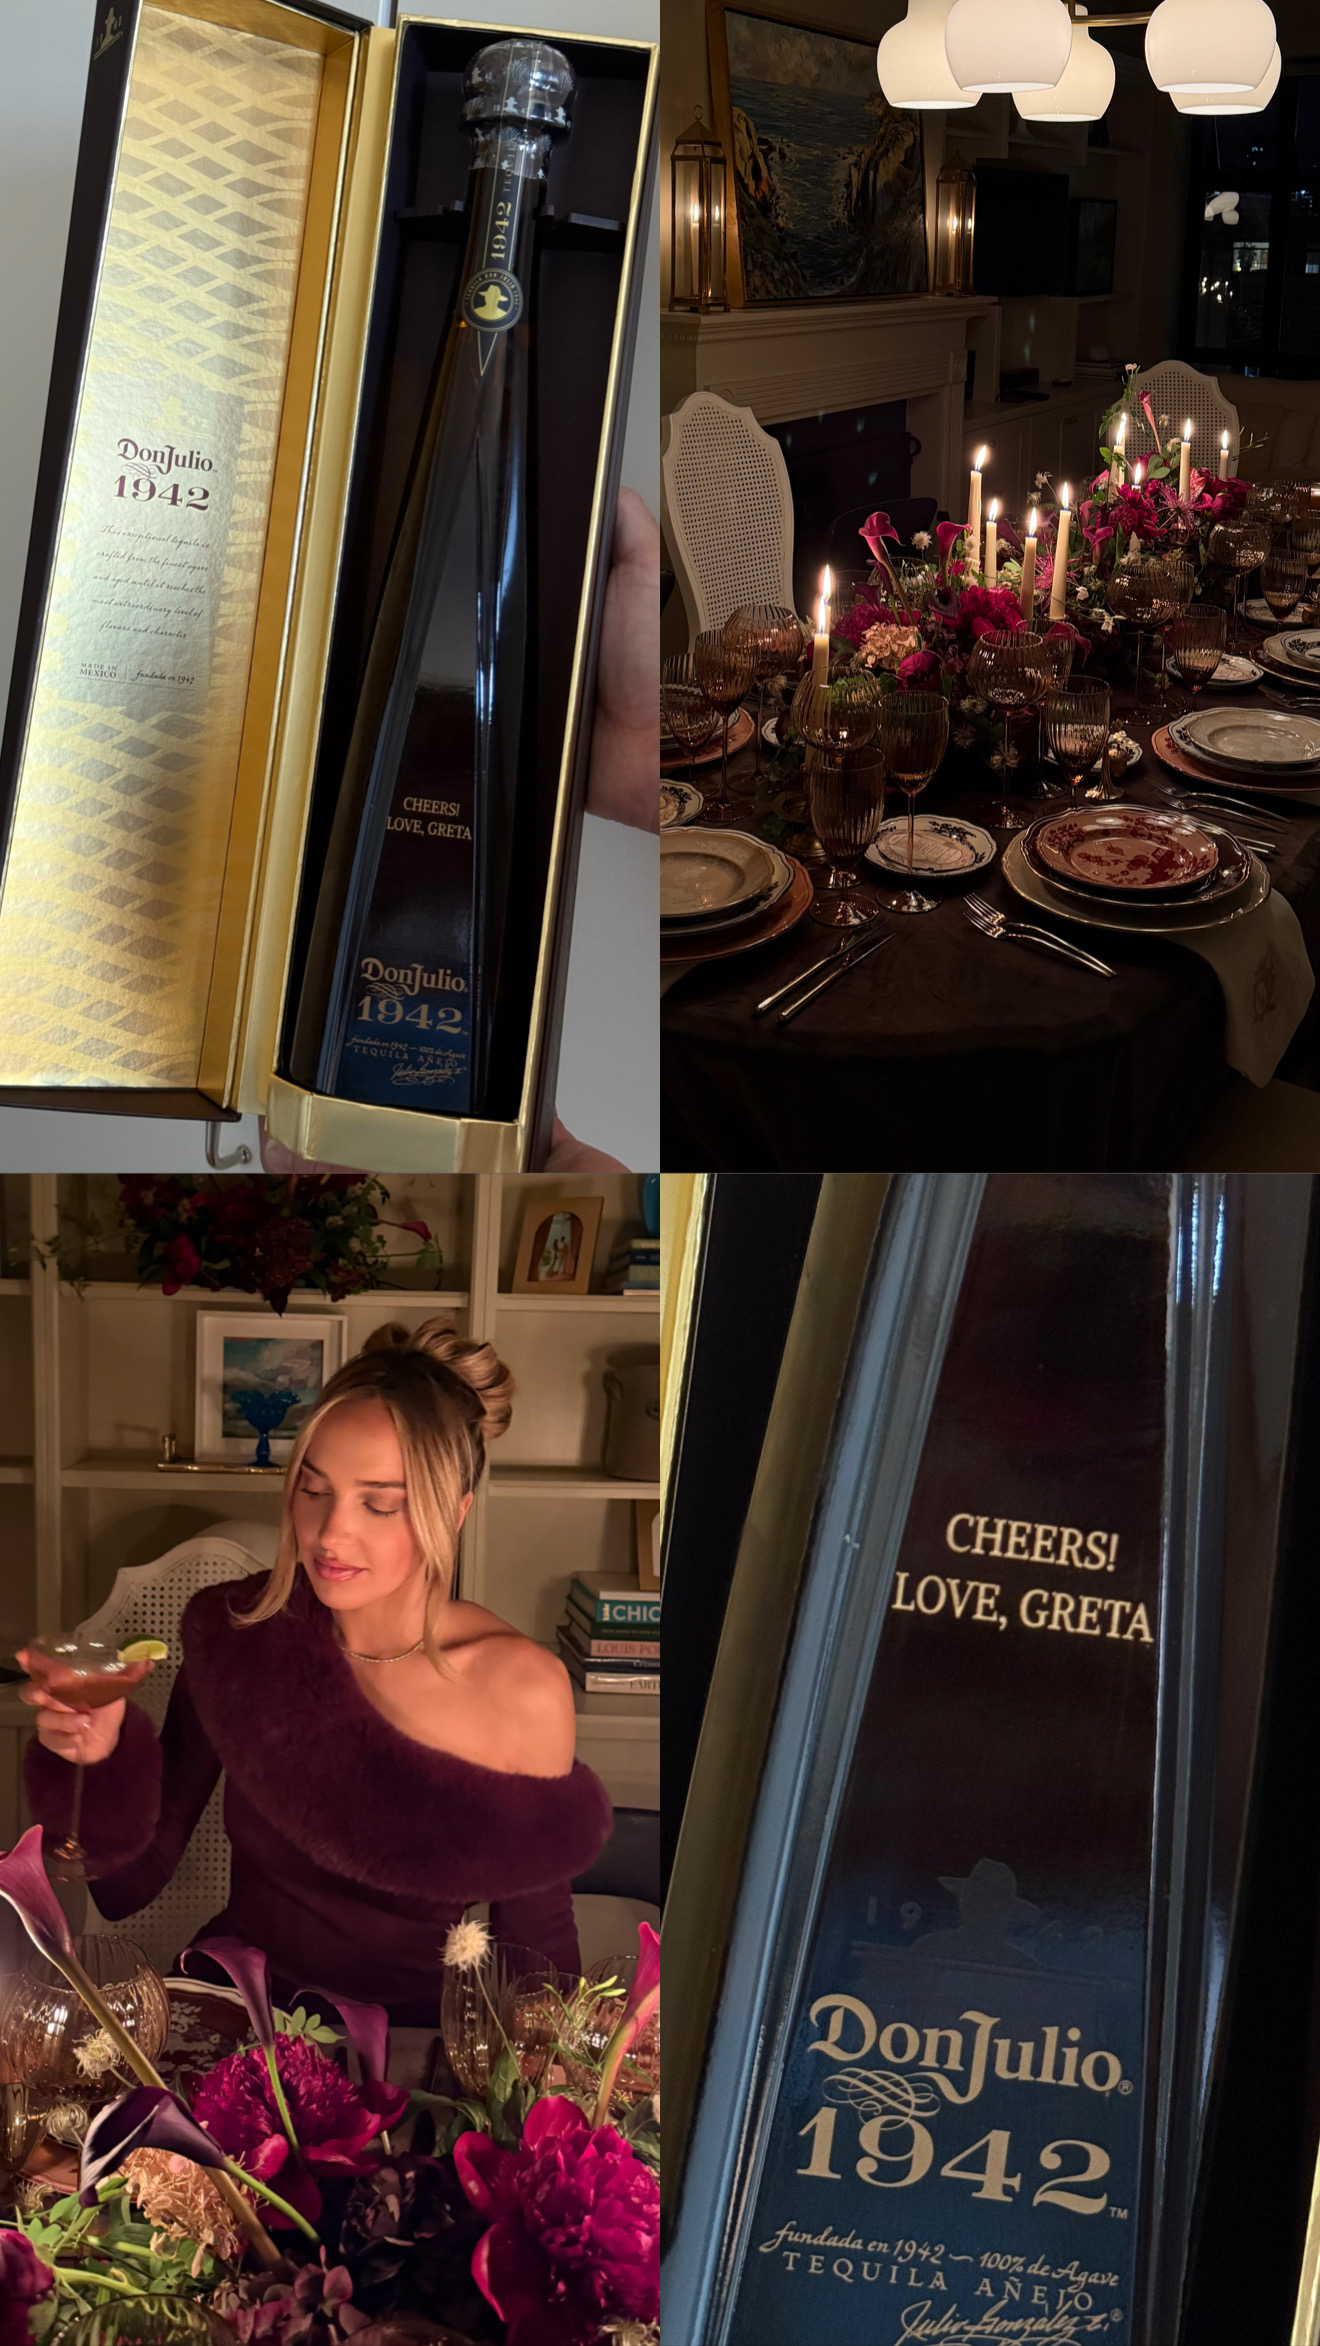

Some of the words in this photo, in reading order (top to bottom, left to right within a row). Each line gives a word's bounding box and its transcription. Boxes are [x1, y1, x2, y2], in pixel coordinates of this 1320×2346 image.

[491, 202, 512, 260] 1942
[113, 474, 210, 511] 1942
[171, 535, 200, 550] tequila
[96, 550, 128, 562] crafted
[126, 552, 147, 564] from
[149, 555, 161, 564] the
[160, 558, 188, 570] finest
[188, 564, 209, 575] agave
[111, 577, 131, 588] aged
[132, 579, 157, 587] until
[155, 581, 165, 589] it
[167, 583, 194, 592] reaches
[194, 585, 206, 595] the
[114, 600, 172, 618] extraordinary
[174, 605, 195, 616] level
[193, 609, 204, 621] of
[98, 620, 131, 633] flavors
[132, 625, 151, 634] and
[150, 626, 188, 638] character
[80, 668, 117, 679] MEXICO
[81, 662, 105, 670] MADE
[131, 670, 166, 681] fundada
[177, 675, 195, 685] 1942
[403, 796, 460, 817] CHEERS!
[386, 816, 425, 837] LOVE,
[427, 821, 473, 840] GRETA
[357, 995, 463, 1034] 1942
[353, 1045, 409, 1060] TEQUILA
[417, 1052, 458, 1067] AÑEJO
[946, 1513, 1119, 1572] CHEERS!
[892, 1571, 1007, 1631] LOVE,
[1019, 1588, 1154, 1643] GRETA
[597, 1643, 636, 1655] LOUIS
[796, 2106, 1111, 2215] 1942
[758, 2220, 863, 2253] fundada
[867, 2240, 890, 2253] en
[893, 2239, 945, 2264] 1942
[980, 2251, 1026, 2273] 100%
[1026, 2254, 1051, 2275] de
[1051, 2260, 1119, 2293] Agave
[782, 2251, 948, 2291] TEQUILA
[974, 2276, 1093, 2311] AÑEJO
